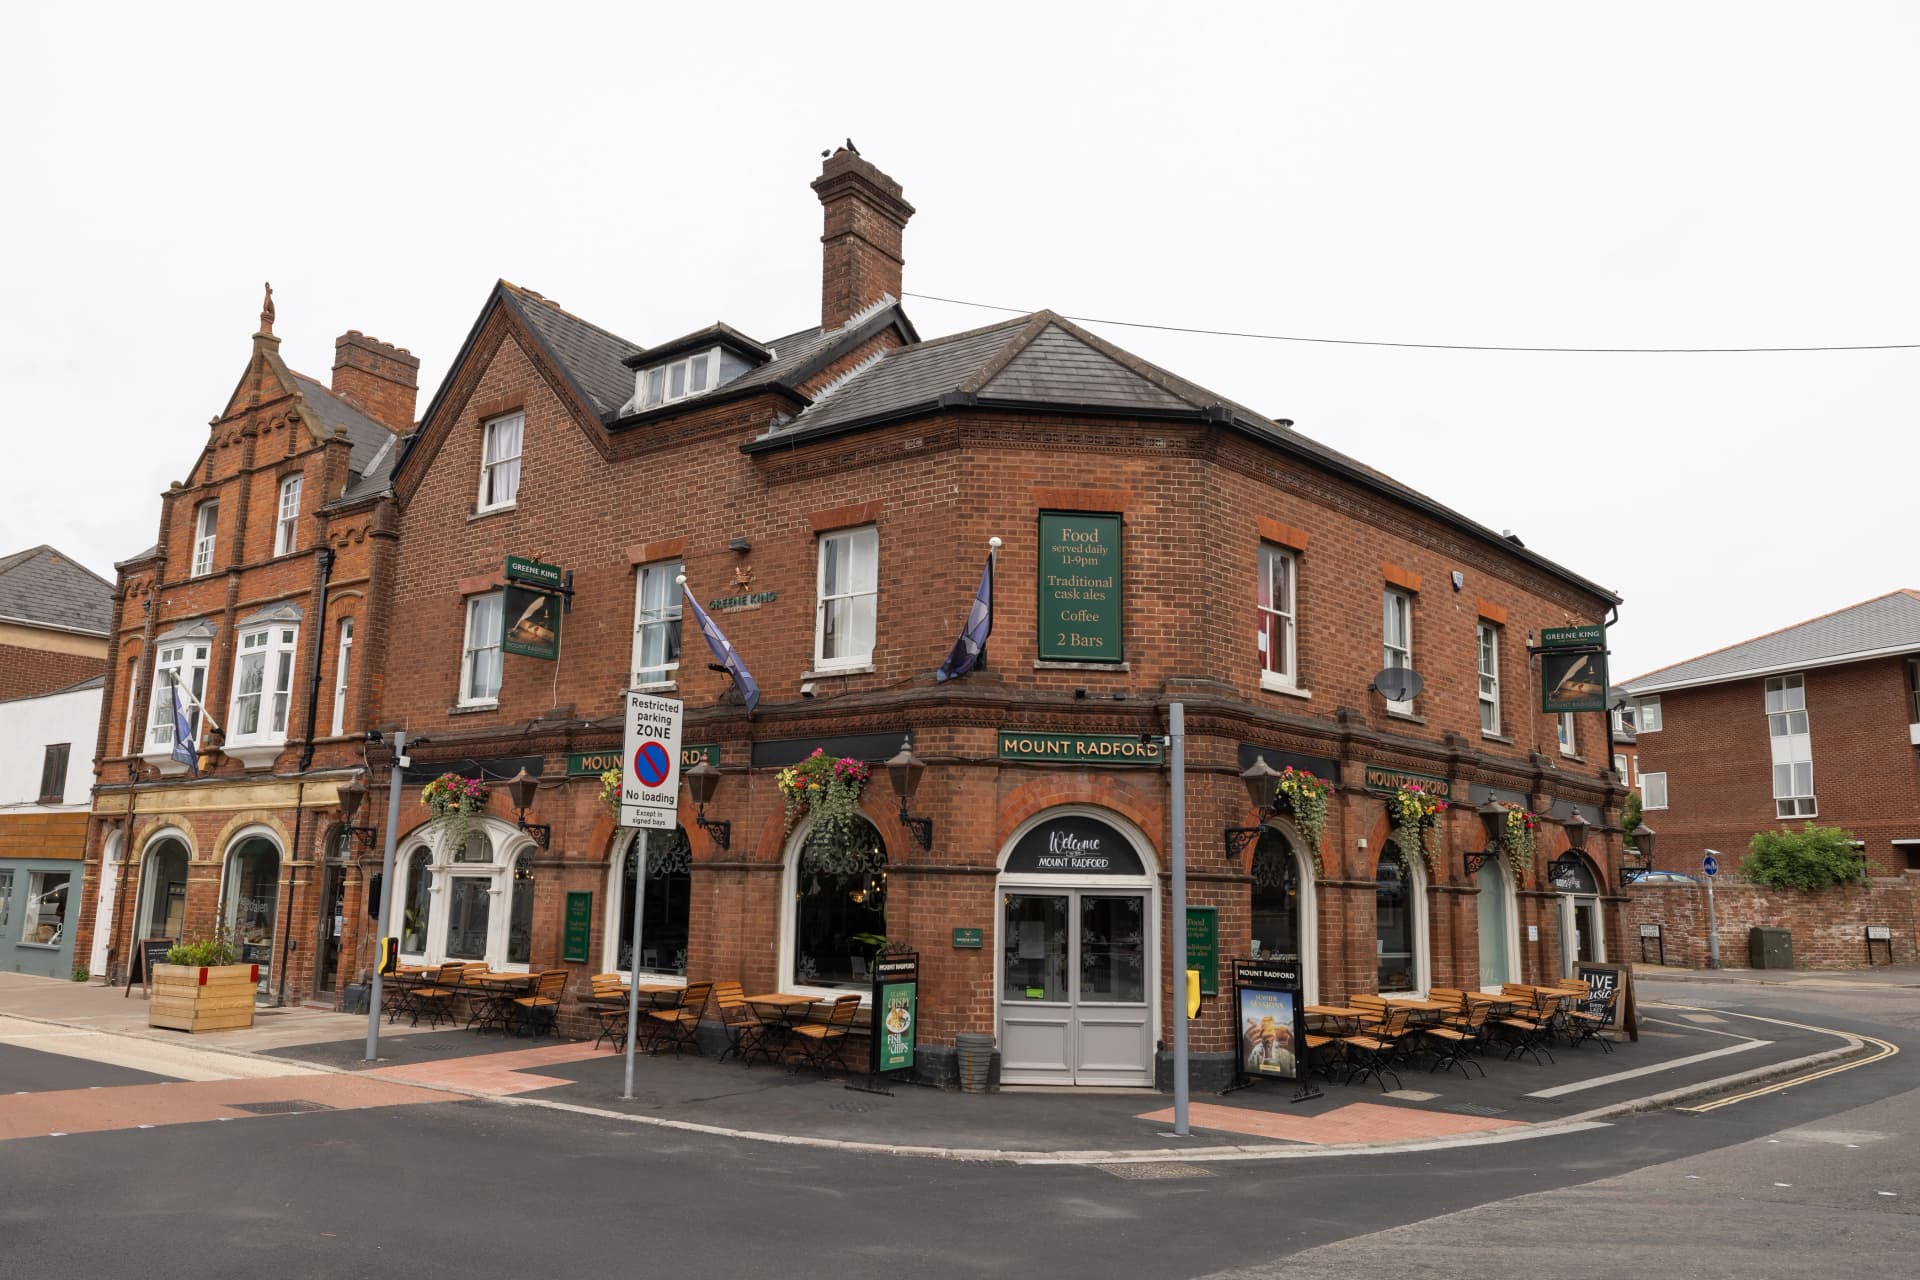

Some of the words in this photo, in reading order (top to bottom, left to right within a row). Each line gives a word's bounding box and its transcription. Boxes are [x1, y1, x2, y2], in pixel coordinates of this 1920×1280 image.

[1062, 528, 1099, 543] Food
[1051, 544, 1083, 553] served
[1085, 544, 1108, 556] daily
[1062, 555, 1098, 567] 11-9pm
[512, 563, 539, 576] GREENE
[541, 570, 558, 580] KING
[1047, 575, 1113, 588] Traditional
[708, 594, 748, 610] GREENE
[750, 592, 777, 604] KING
[1054, 588, 1080, 600] cask
[1083, 589, 1106, 600] ales
[1060, 609, 1099, 622] Coffee
[1056, 633, 1066, 646] 2
[1070, 633, 1104, 647] Bars
[1545, 633, 1577, 641] GREENE
[631, 697, 679, 714] Restricted
[637, 712, 672, 726] parking
[636, 724, 671, 739] ZONE
[1004, 739, 1071, 754] MOUNT
[1076, 741, 1159, 757] RADFORD
[582, 755, 623, 770] MOUN
[1368, 770, 1404, 786] MOUNT
[626, 789, 639, 800] No
[642, 791, 675, 805] loading
[636, 809, 656, 818] Except
[632, 817, 651, 825] signed
[652, 818, 666, 826] bays
[1049, 830, 1100, 853] Welcome
[1038, 857, 1069, 867] MOUNT
[1071, 858, 1109, 868] RADFORD
[1239, 969, 1263, 977] MOUNT
[1264, 971, 1295, 979] RADFORD
